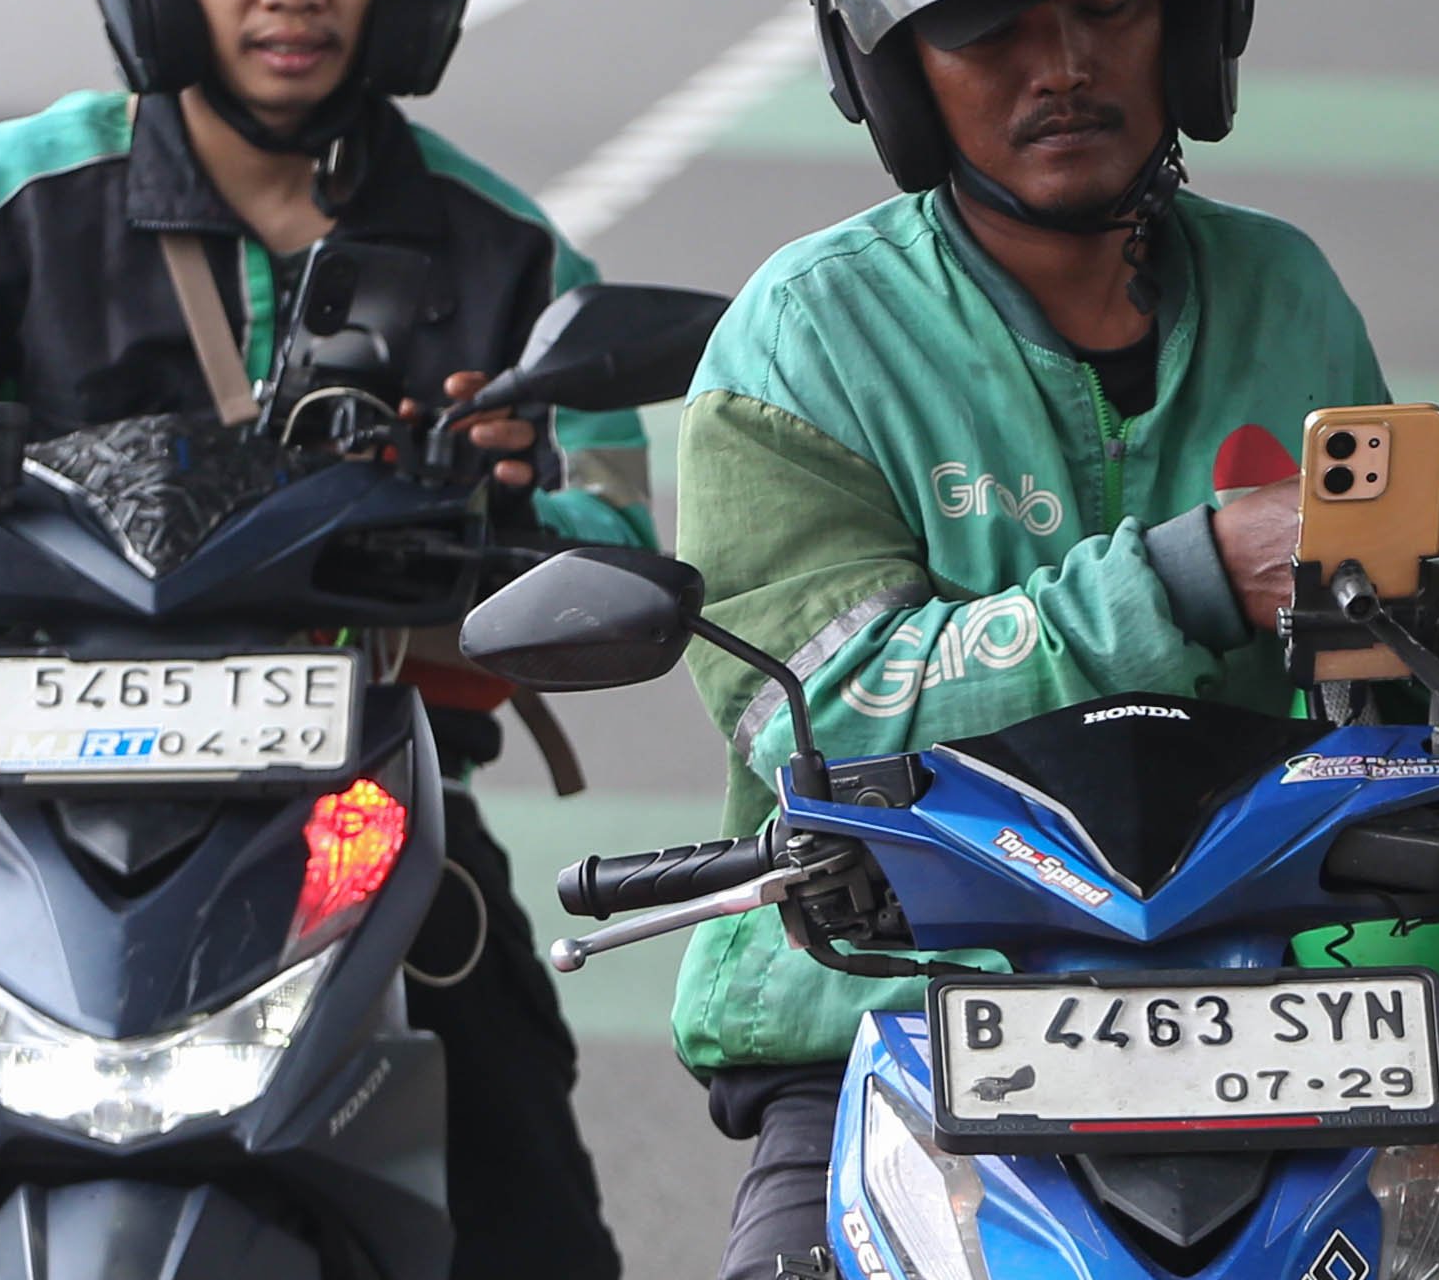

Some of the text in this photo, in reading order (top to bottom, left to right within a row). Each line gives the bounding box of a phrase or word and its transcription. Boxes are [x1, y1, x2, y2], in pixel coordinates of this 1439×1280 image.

[34, 667, 194, 710] 5465
[224, 664, 340, 709] TSE
[1082, 705, 1191, 724] HONDA
[963, 989, 1405, 1050] B 4463 SYN
